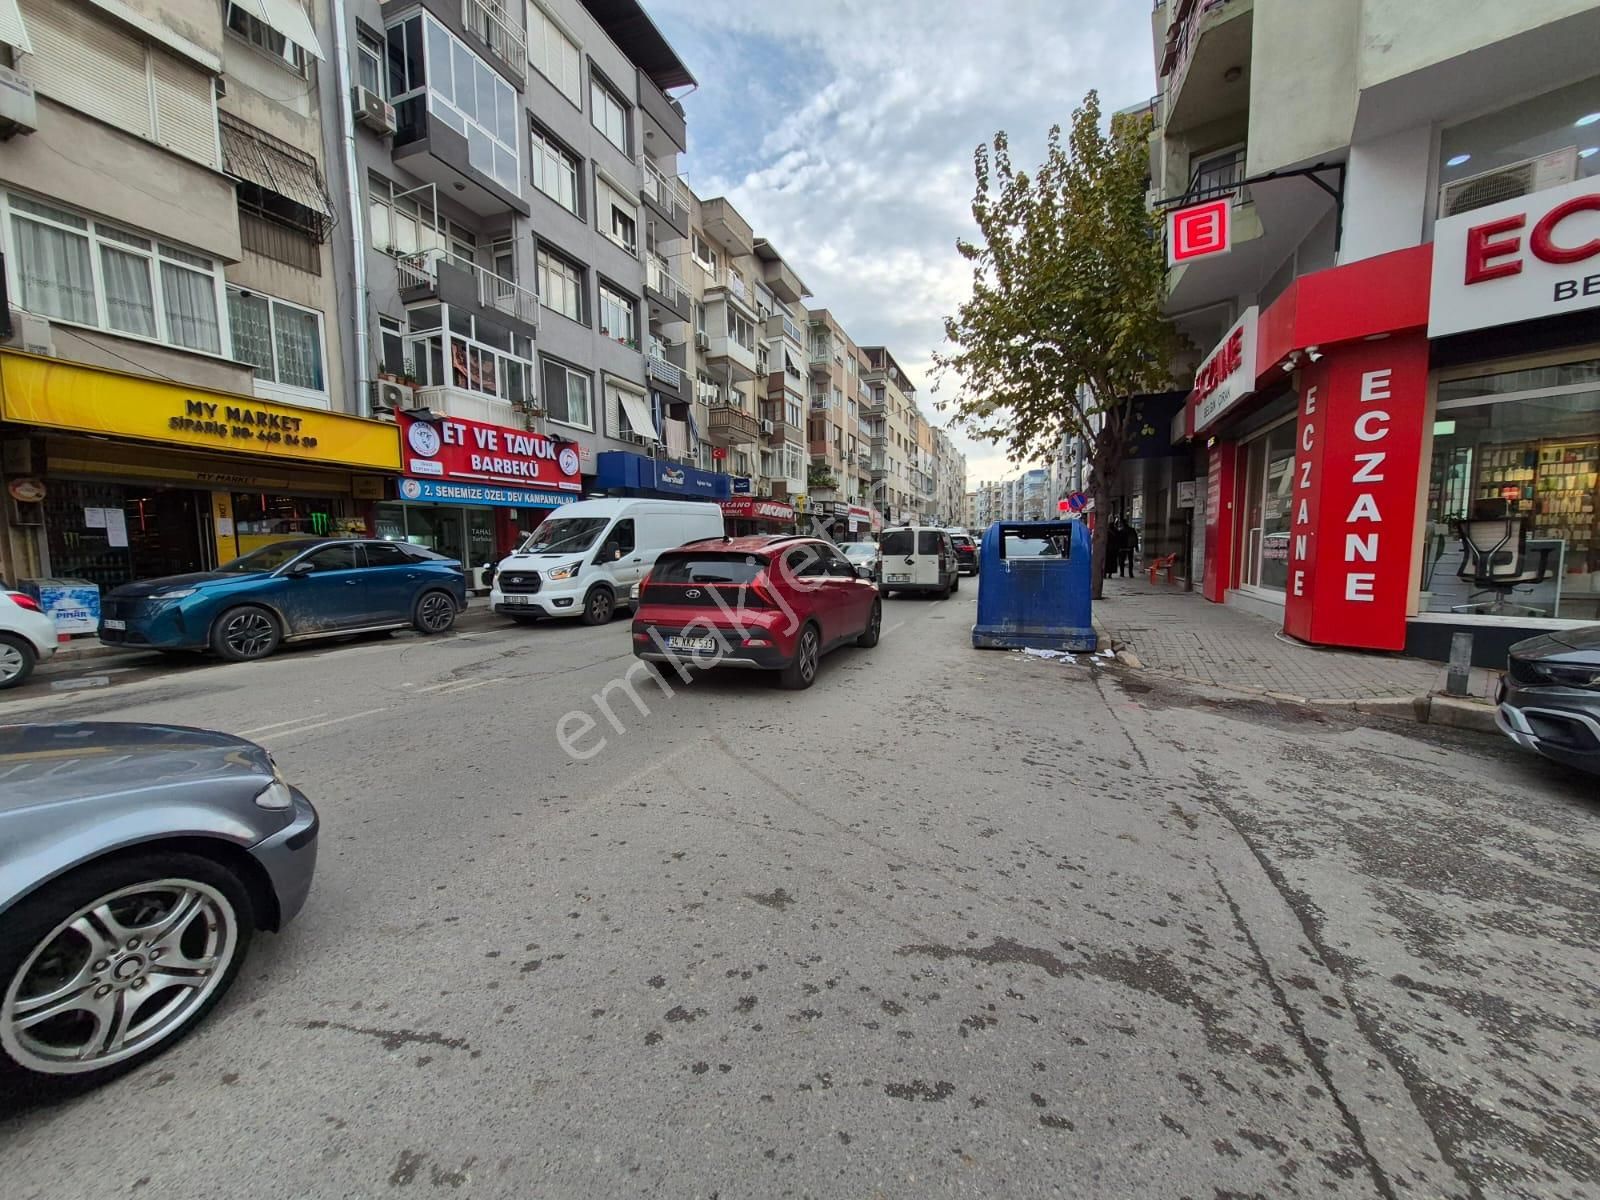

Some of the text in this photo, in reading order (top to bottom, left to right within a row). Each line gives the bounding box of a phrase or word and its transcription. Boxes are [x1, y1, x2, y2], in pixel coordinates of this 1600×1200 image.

[186, 399, 303, 432] MY MARKET
[442, 422, 467, 446] ET
[472, 427, 498, 451] VE
[503, 433, 557, 461] TAVUK
[471, 454, 539, 478] BARBEKÜ
[435, 486, 482, 499] SENEMİZE
[507, 491, 523, 502] DEV
[524, 492, 574, 505] KAMPANYALAR
[1293, 385, 1318, 597] ECZANE
[1344, 368, 1393, 602] ECZANE
